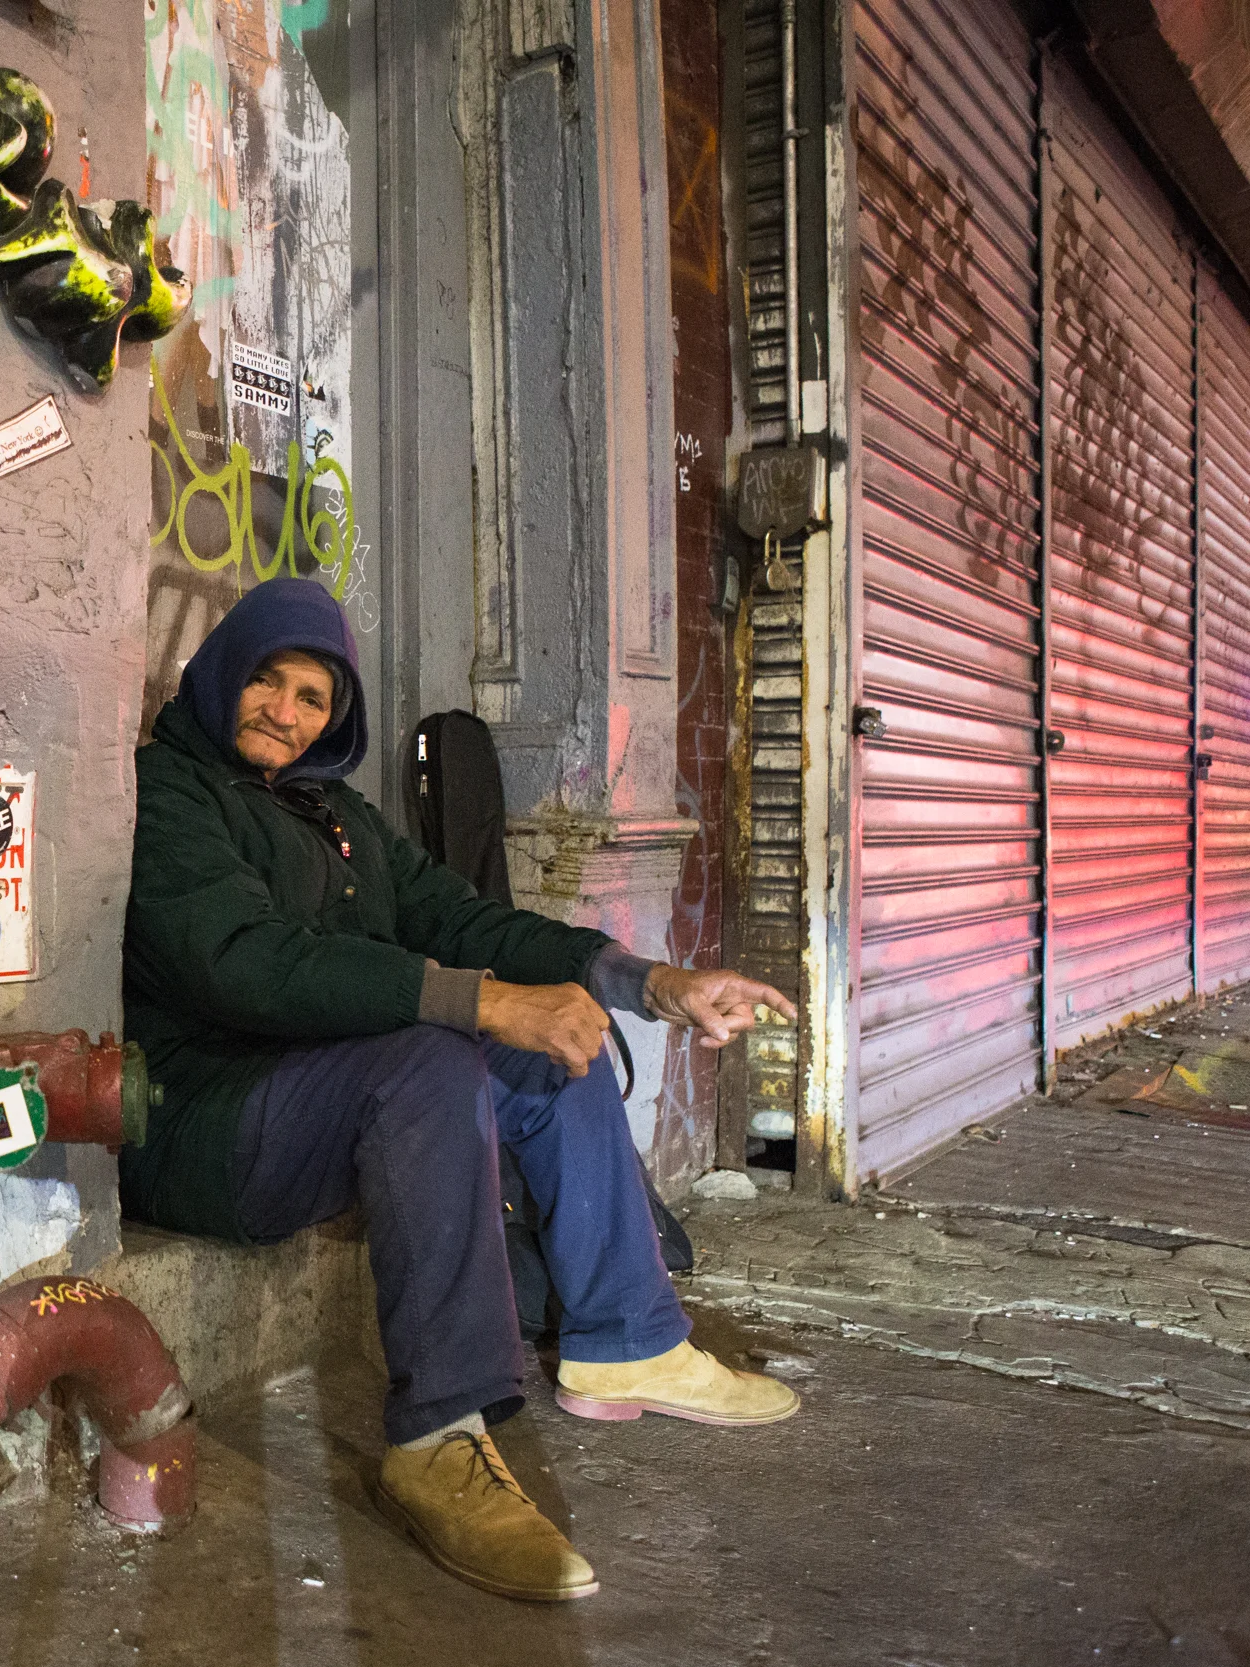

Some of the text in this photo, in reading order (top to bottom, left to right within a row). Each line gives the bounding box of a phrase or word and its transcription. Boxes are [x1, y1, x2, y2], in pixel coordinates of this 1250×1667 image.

[234, 344, 289, 370] SO MANY LIKES
[234, 353, 289, 378] SO LITTLE LOVE
[234, 384, 289, 412] SAMMY
[0, 439, 18, 452] New
[185, 429, 214, 443] DISCOVER
